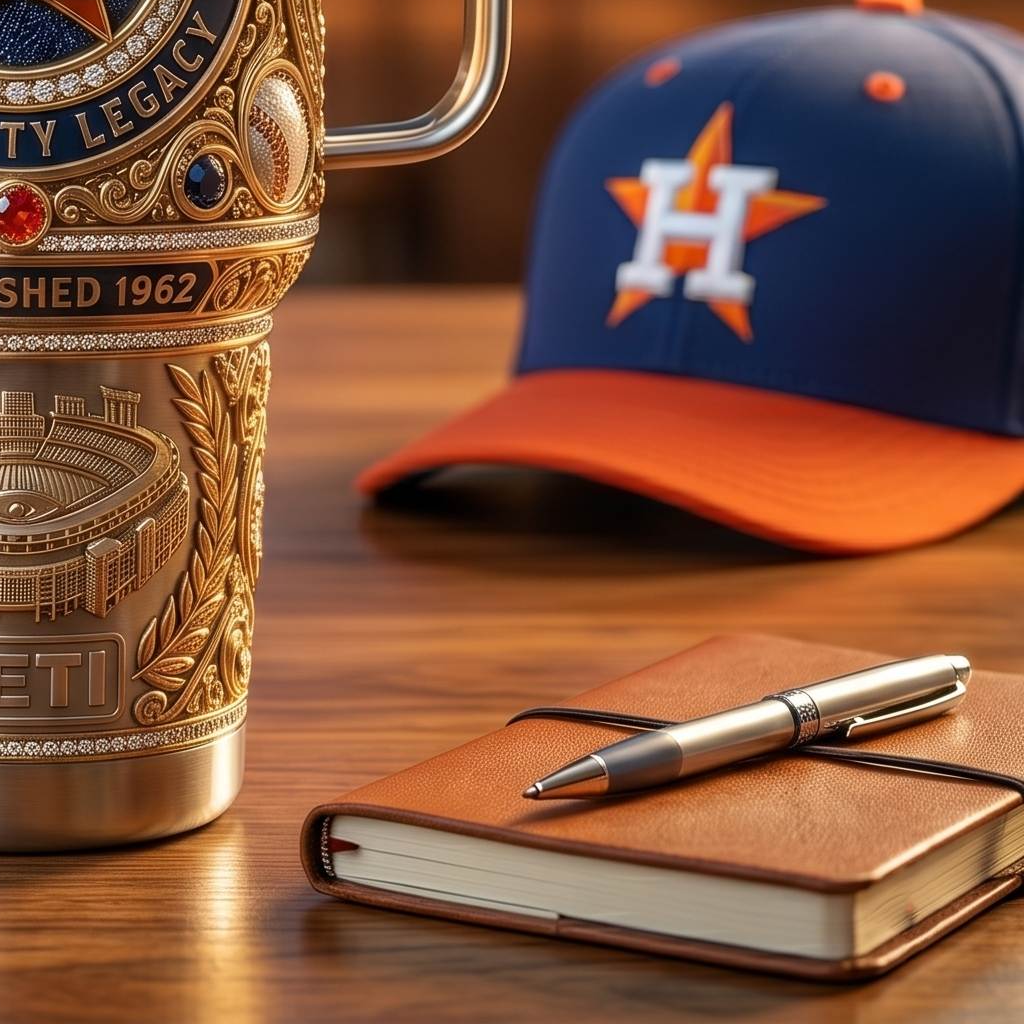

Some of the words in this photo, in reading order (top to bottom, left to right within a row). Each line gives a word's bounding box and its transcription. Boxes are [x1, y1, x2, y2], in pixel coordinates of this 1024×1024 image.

[75, 10, 219, 149] LEGACY
[114, 272, 198, 307] 1962
[616, 158, 779, 304] H
